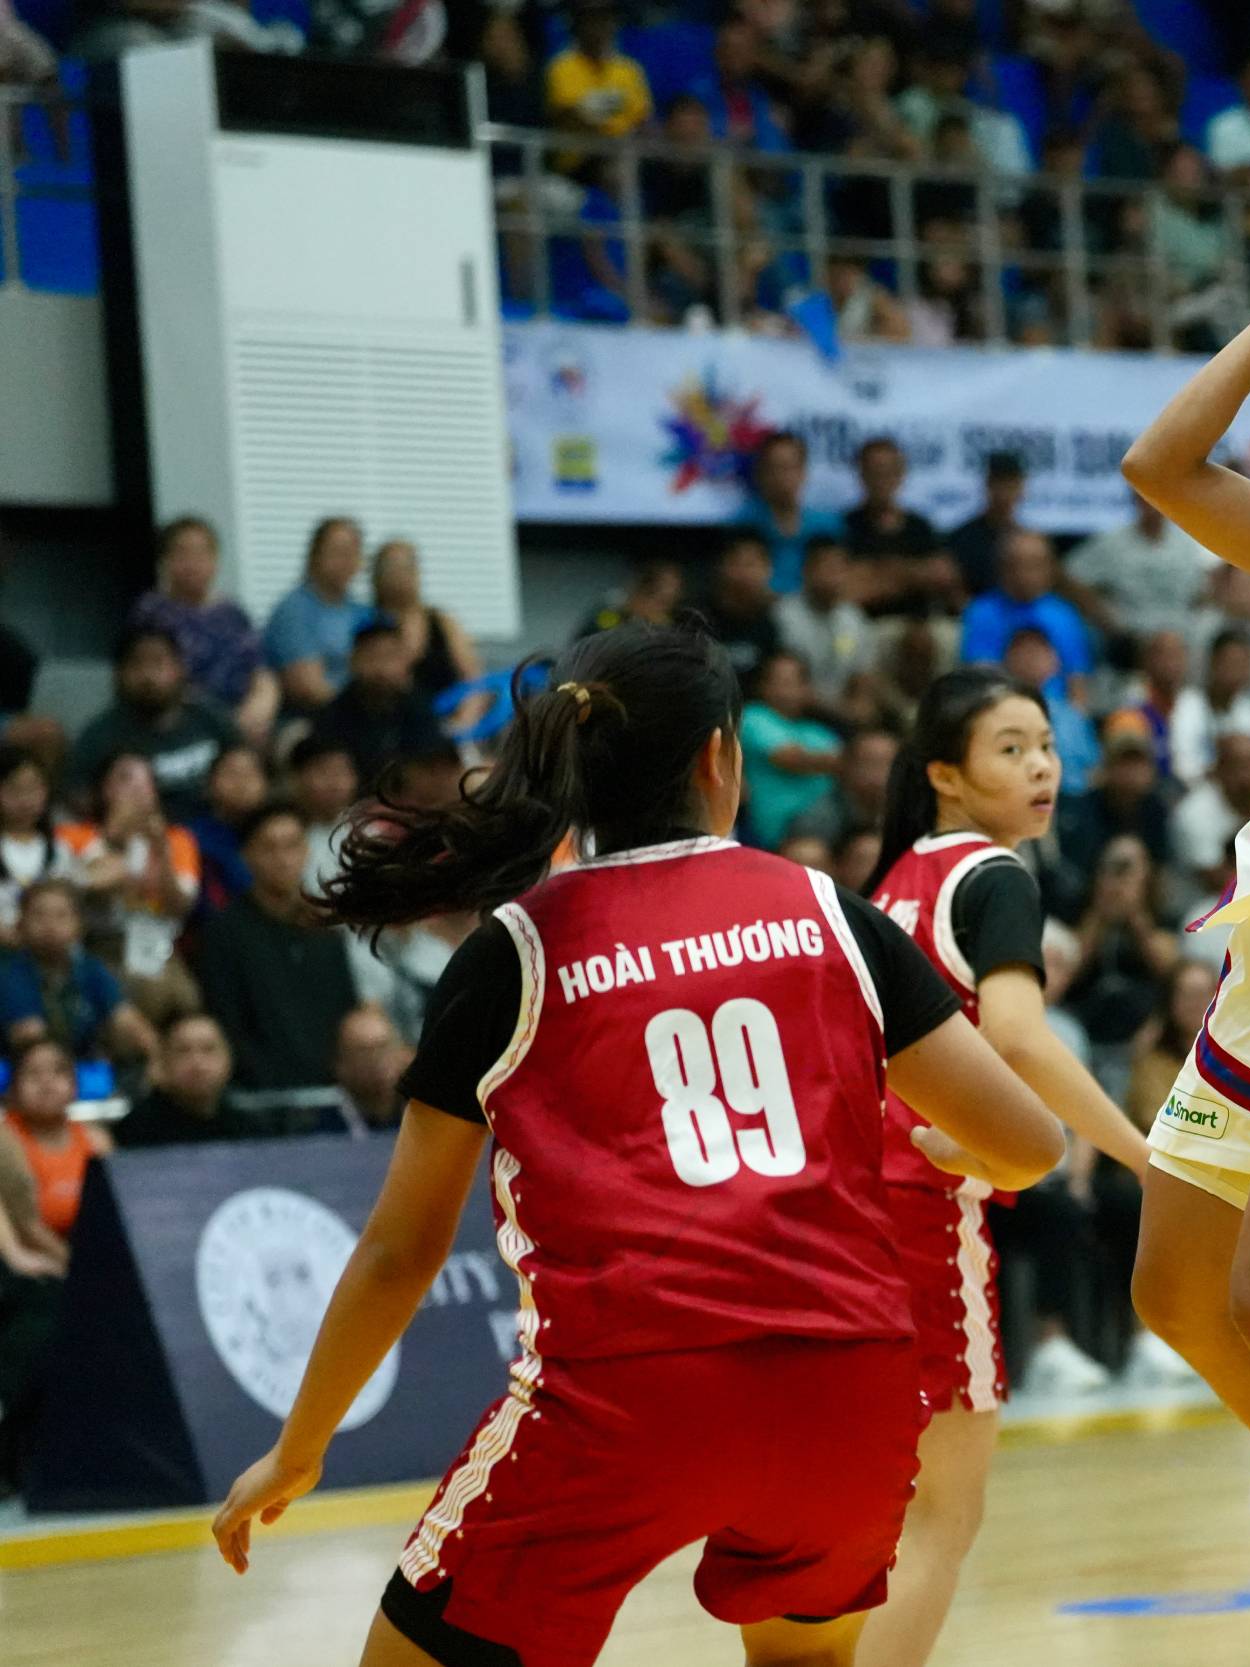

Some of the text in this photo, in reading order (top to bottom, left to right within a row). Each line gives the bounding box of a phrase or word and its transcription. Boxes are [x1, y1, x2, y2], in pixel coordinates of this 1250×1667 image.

[557, 918, 824, 1004] HOÀI THƯƠNG
[644, 997, 806, 1187] 89
[1173, 1101, 1219, 1129] Smart
